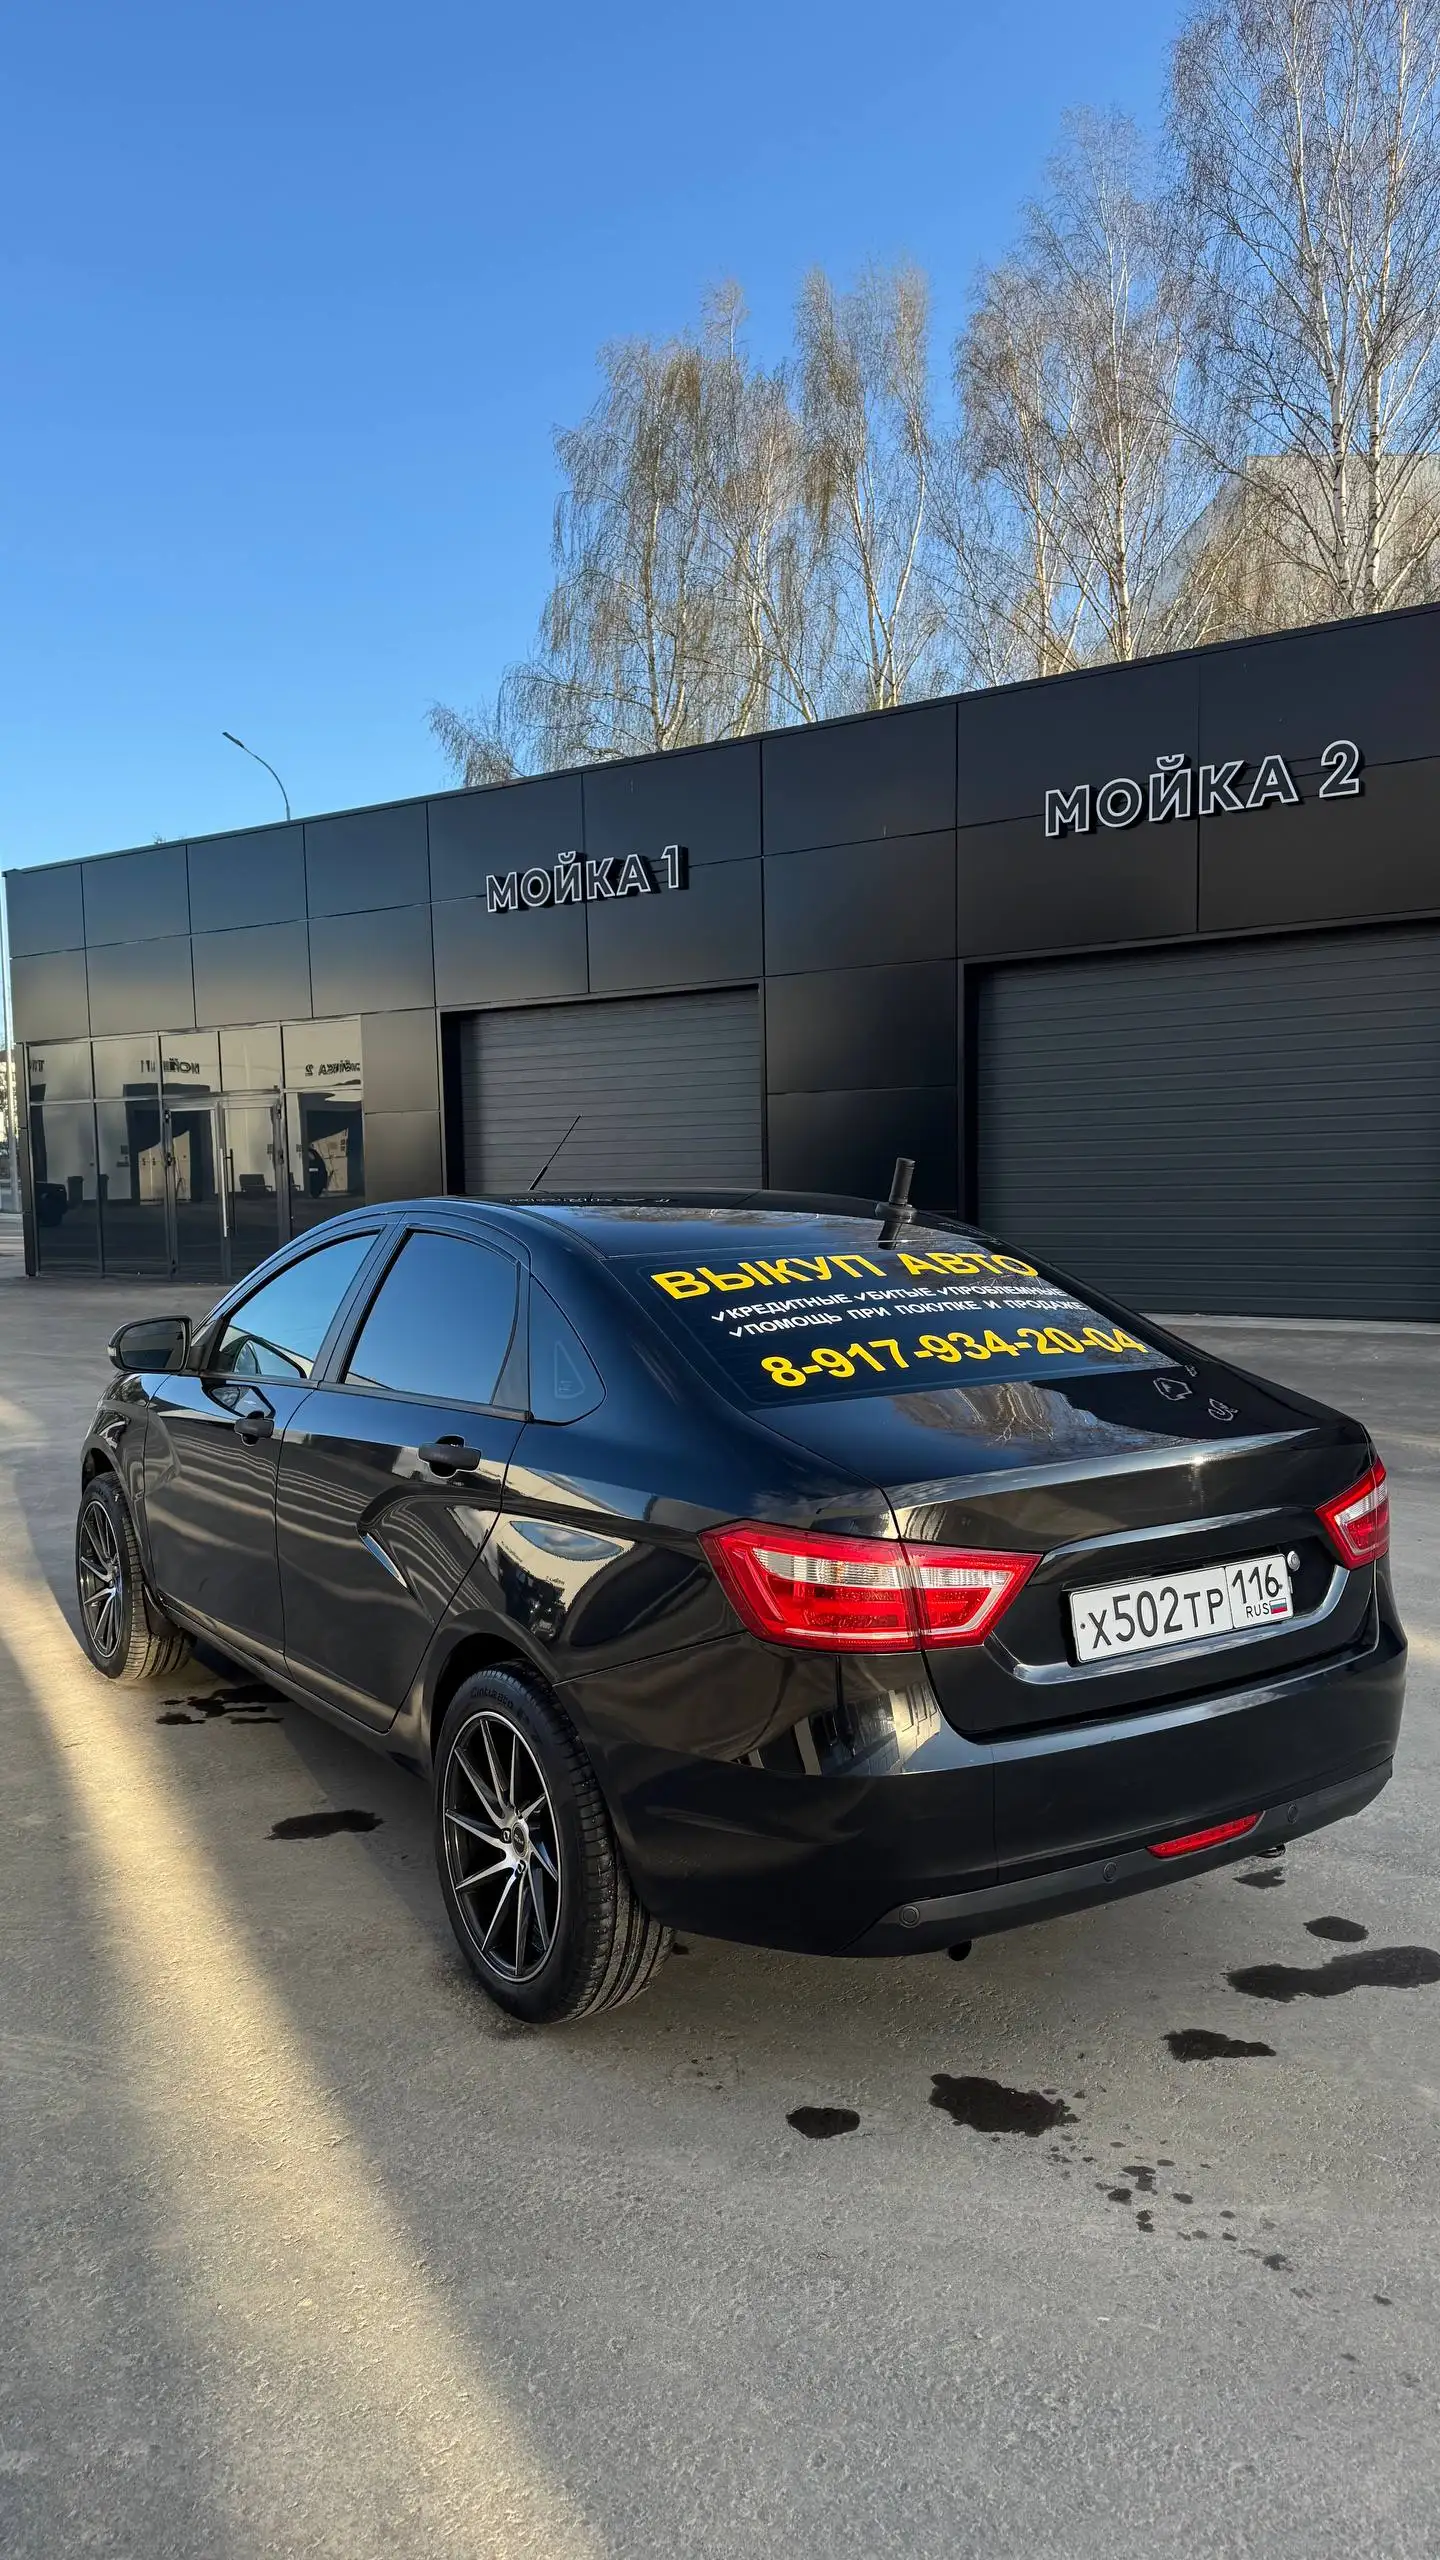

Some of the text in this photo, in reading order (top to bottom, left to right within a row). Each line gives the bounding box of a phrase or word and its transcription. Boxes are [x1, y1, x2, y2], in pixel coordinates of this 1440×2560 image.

[1045, 739, 1360, 837] МОЙКА 2
[486, 845, 680, 912] МОЙКА 1
[651, 1252, 1039, 1300] ВЫКУП АВТО
[725, 1285, 1068, 1320] КРЕДИТНЫЕ БИТЫЕ ПРОБЛЕМНЫЕ
[743, 1299, 1089, 1335] ПОМОЩЬ ПРИ ПОКУПКЕ И ПРОДАЖЕ
[761, 1327, 1149, 1387] 8-917-934-20-04
[1088, 1563, 1280, 1650] Х502ТР 116
[1246, 1602, 1270, 1619] RUS
